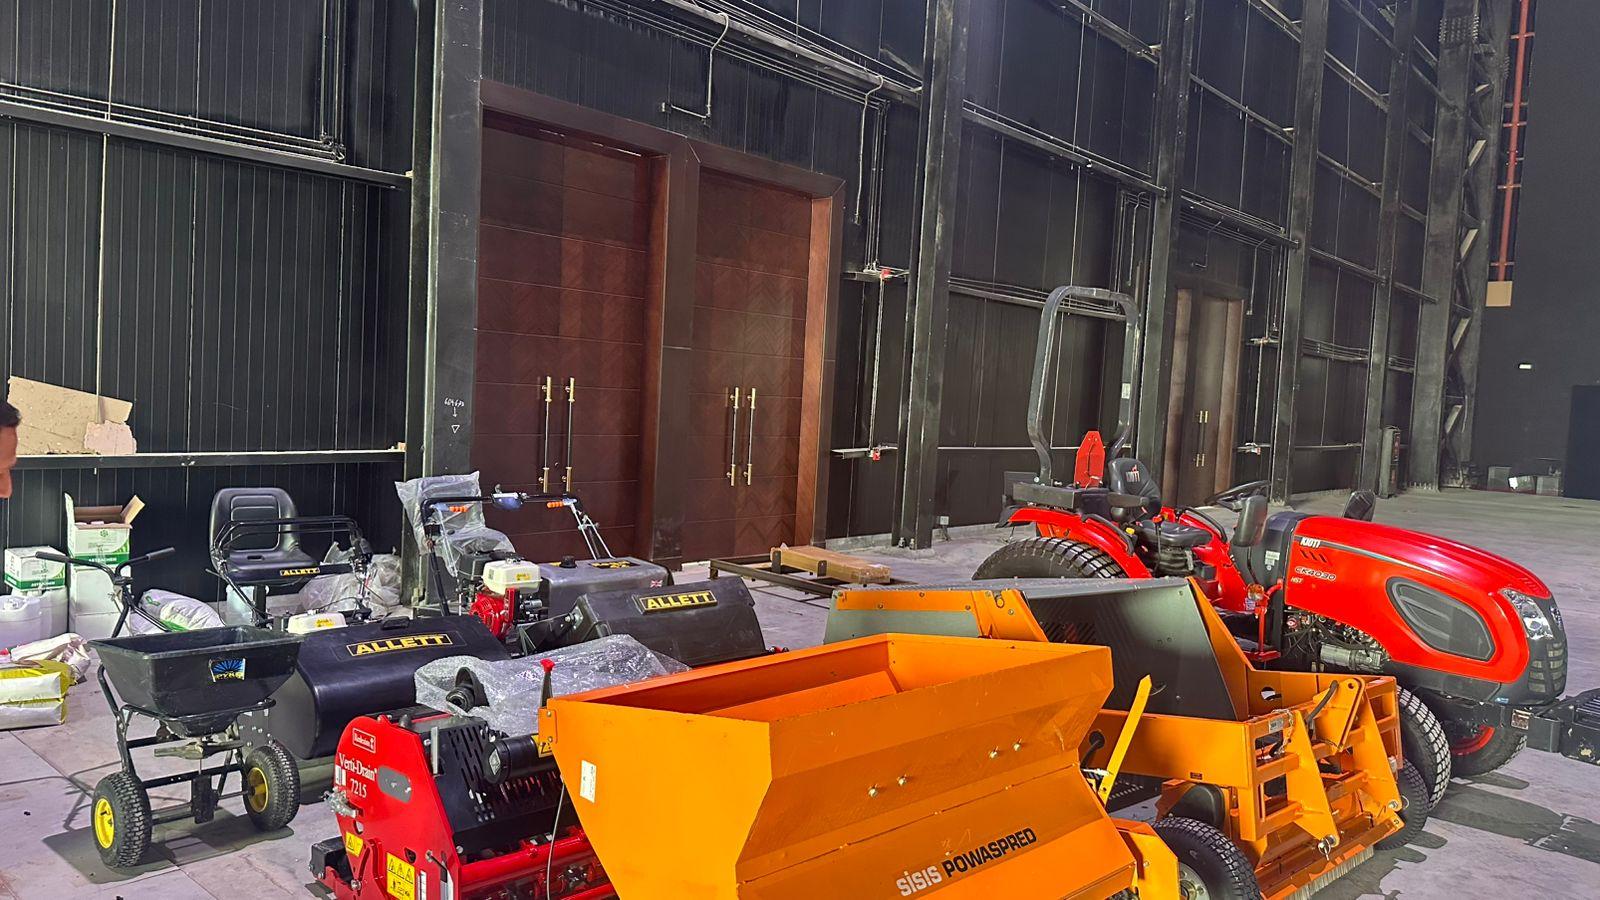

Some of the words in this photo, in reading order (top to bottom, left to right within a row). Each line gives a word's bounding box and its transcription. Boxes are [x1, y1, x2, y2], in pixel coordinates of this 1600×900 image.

[1300, 536, 1321, 549] KIOTI
[282, 567, 319, 577] ALLETT
[647, 592, 710, 609] ALLETT
[356, 635, 445, 656] ALLETT
[350, 778, 367, 798] 7215
[941, 827, 1037, 878] POWASPRED
